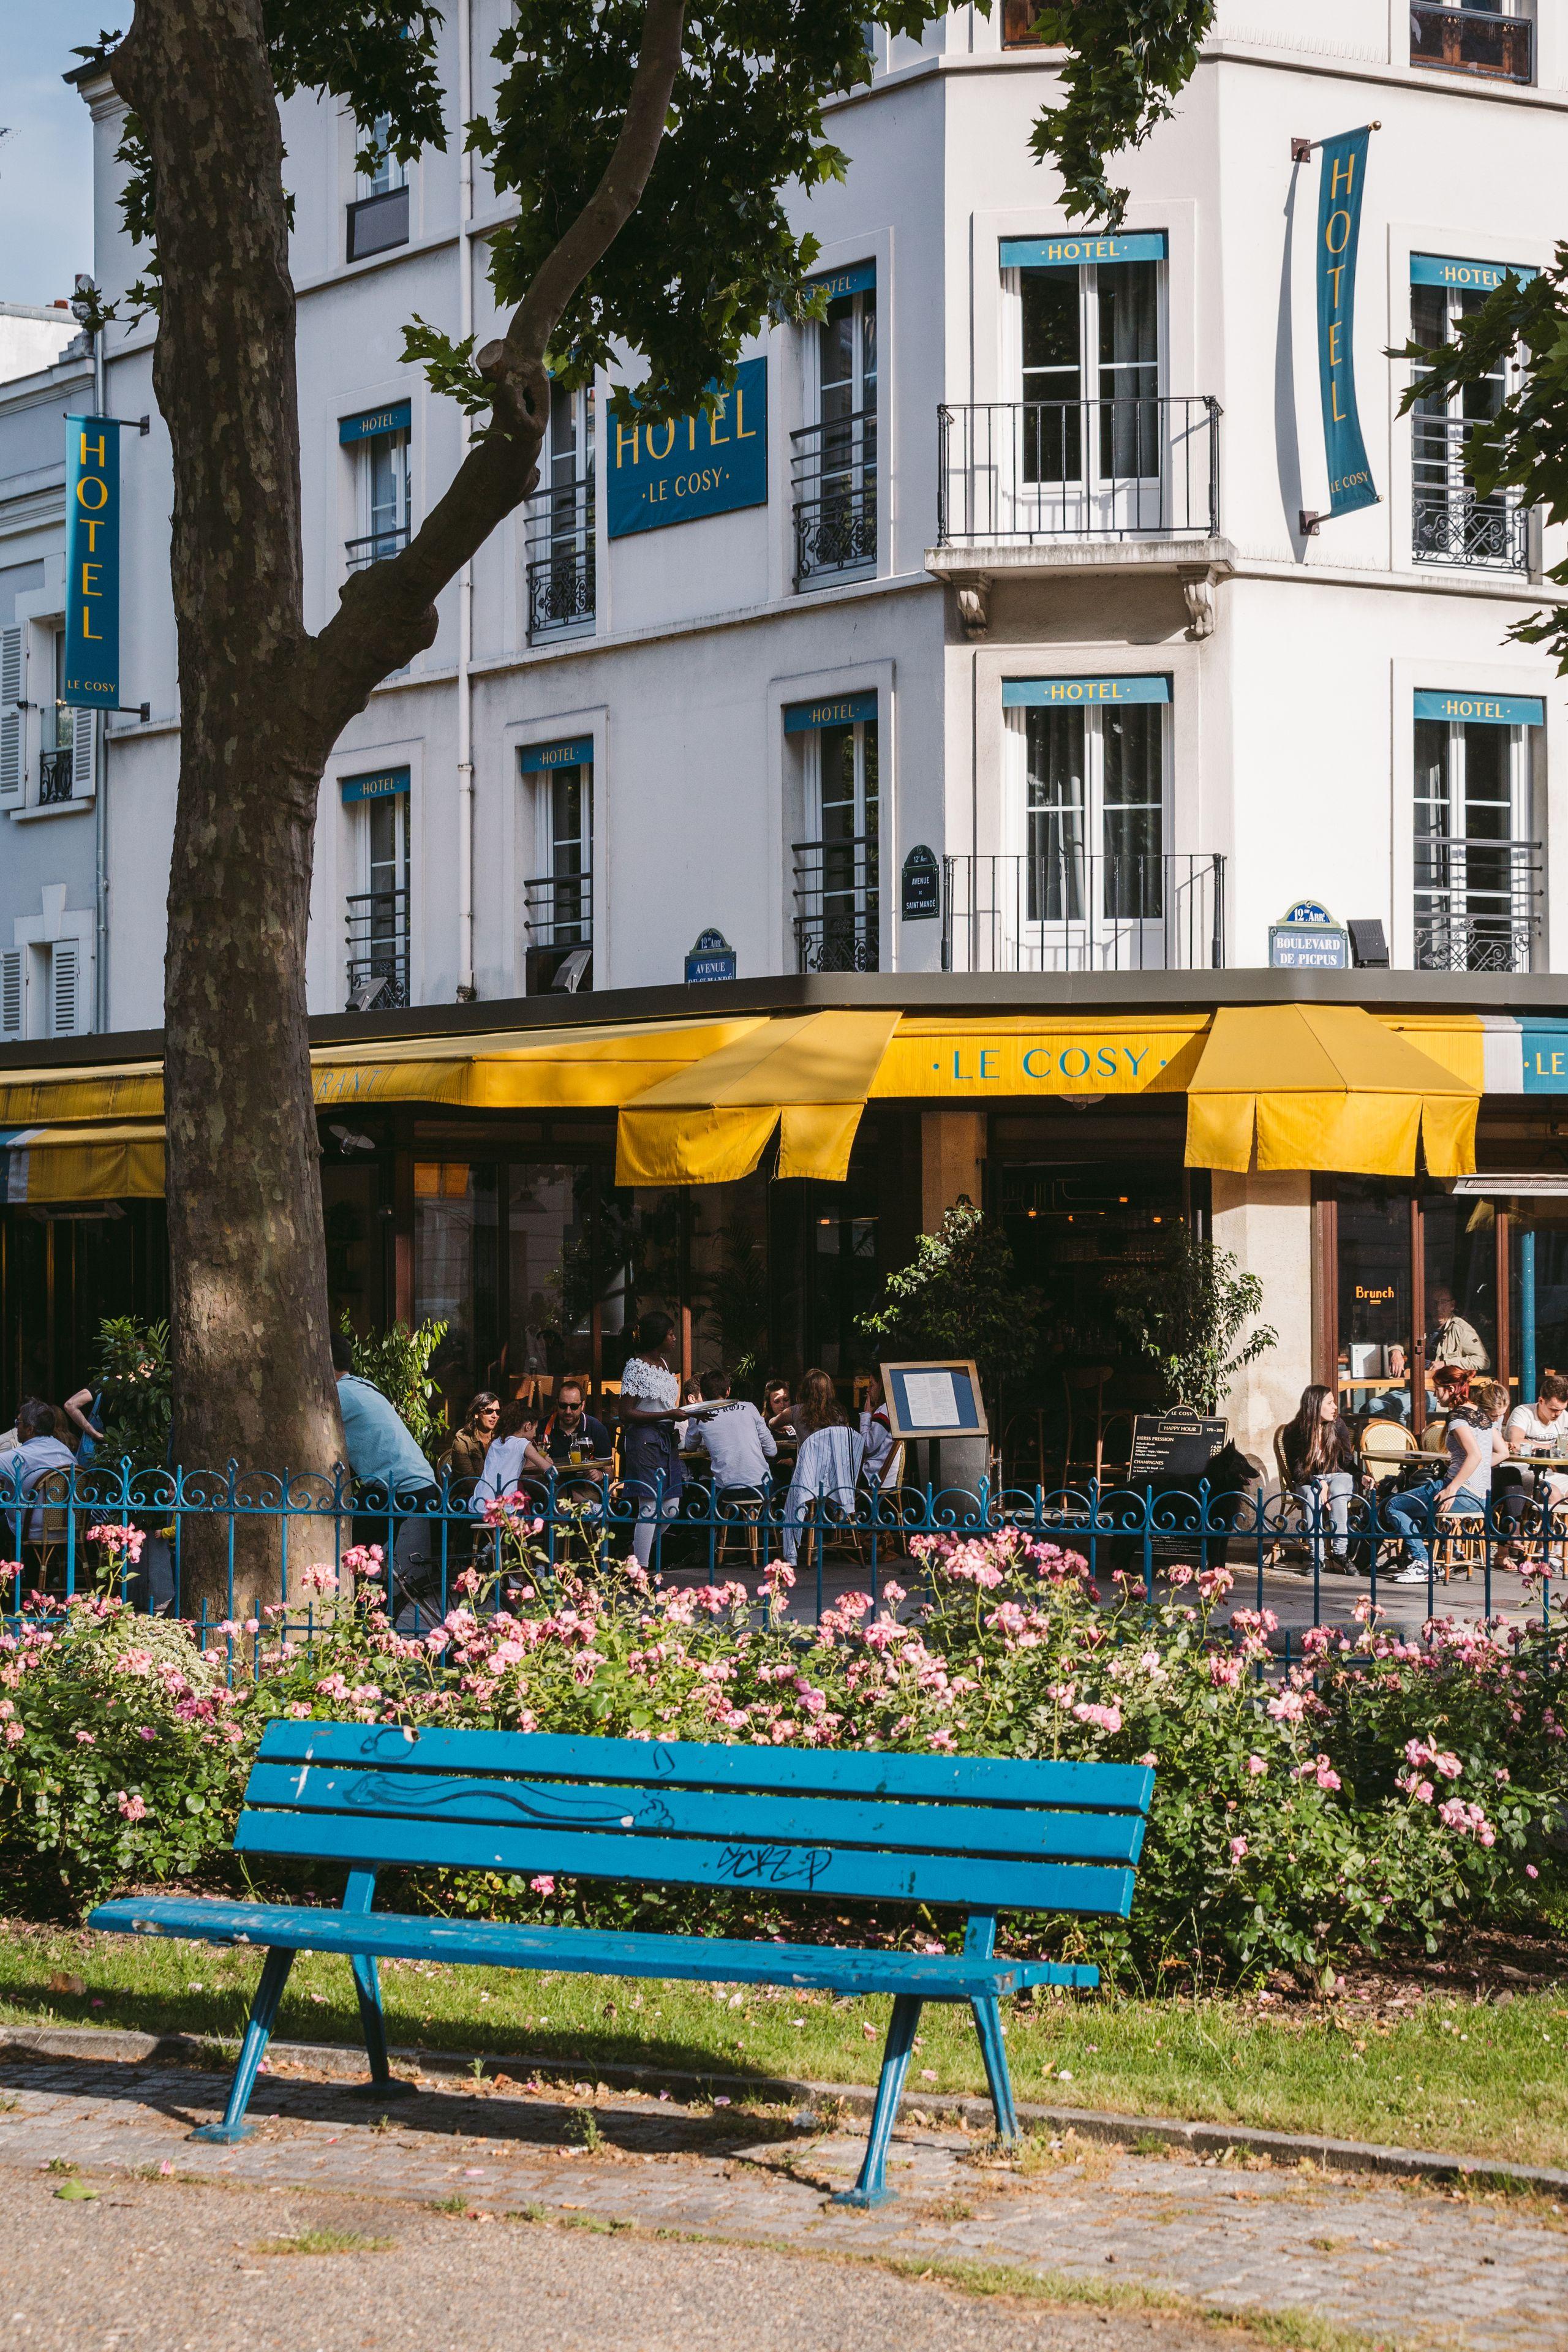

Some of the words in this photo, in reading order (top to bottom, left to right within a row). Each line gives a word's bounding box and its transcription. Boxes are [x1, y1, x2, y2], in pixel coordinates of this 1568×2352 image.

[1049, 241, 1120, 260] HOTEL
[1444, 266, 1501, 286] HOTEL
[813, 276, 852, 298] OTEL
[1325, 153, 1355, 423] HOTEL
[362, 413, 394, 432] HOTEL
[649, 480, 668, 503] LE
[675, 466, 723, 497] COSY
[1330, 477, 1341, 494] LE
[1343, 470, 1369, 489] COSY
[76, 432, 108, 640] HOTEL
[68, 679, 80, 689] LE
[85, 681, 116, 693] COSY
[1052, 684, 1122, 699] HOTEL
[813, 704, 855, 723] HOTEL
[1447, 700, 1504, 718] HOTEL
[543, 747, 575, 765] HOTEL
[363, 777, 395, 795] HOTEL
[912, 877, 930, 886] AVENUE
[920, 899, 936, 908] MANDÉ
[1276, 938, 1341, 950] BOULEVARD
[696, 962, 725, 974] AVENUE
[1280, 953, 1295, 964] DE
[1298, 954, 1338, 966] PICPUS
[953, 1049, 1000, 1080] LE
[1022, 1046, 1149, 1079] COSY
[1536, 1052, 1565, 1075] LE
[1355, 1286, 1395, 1299] Brunch
